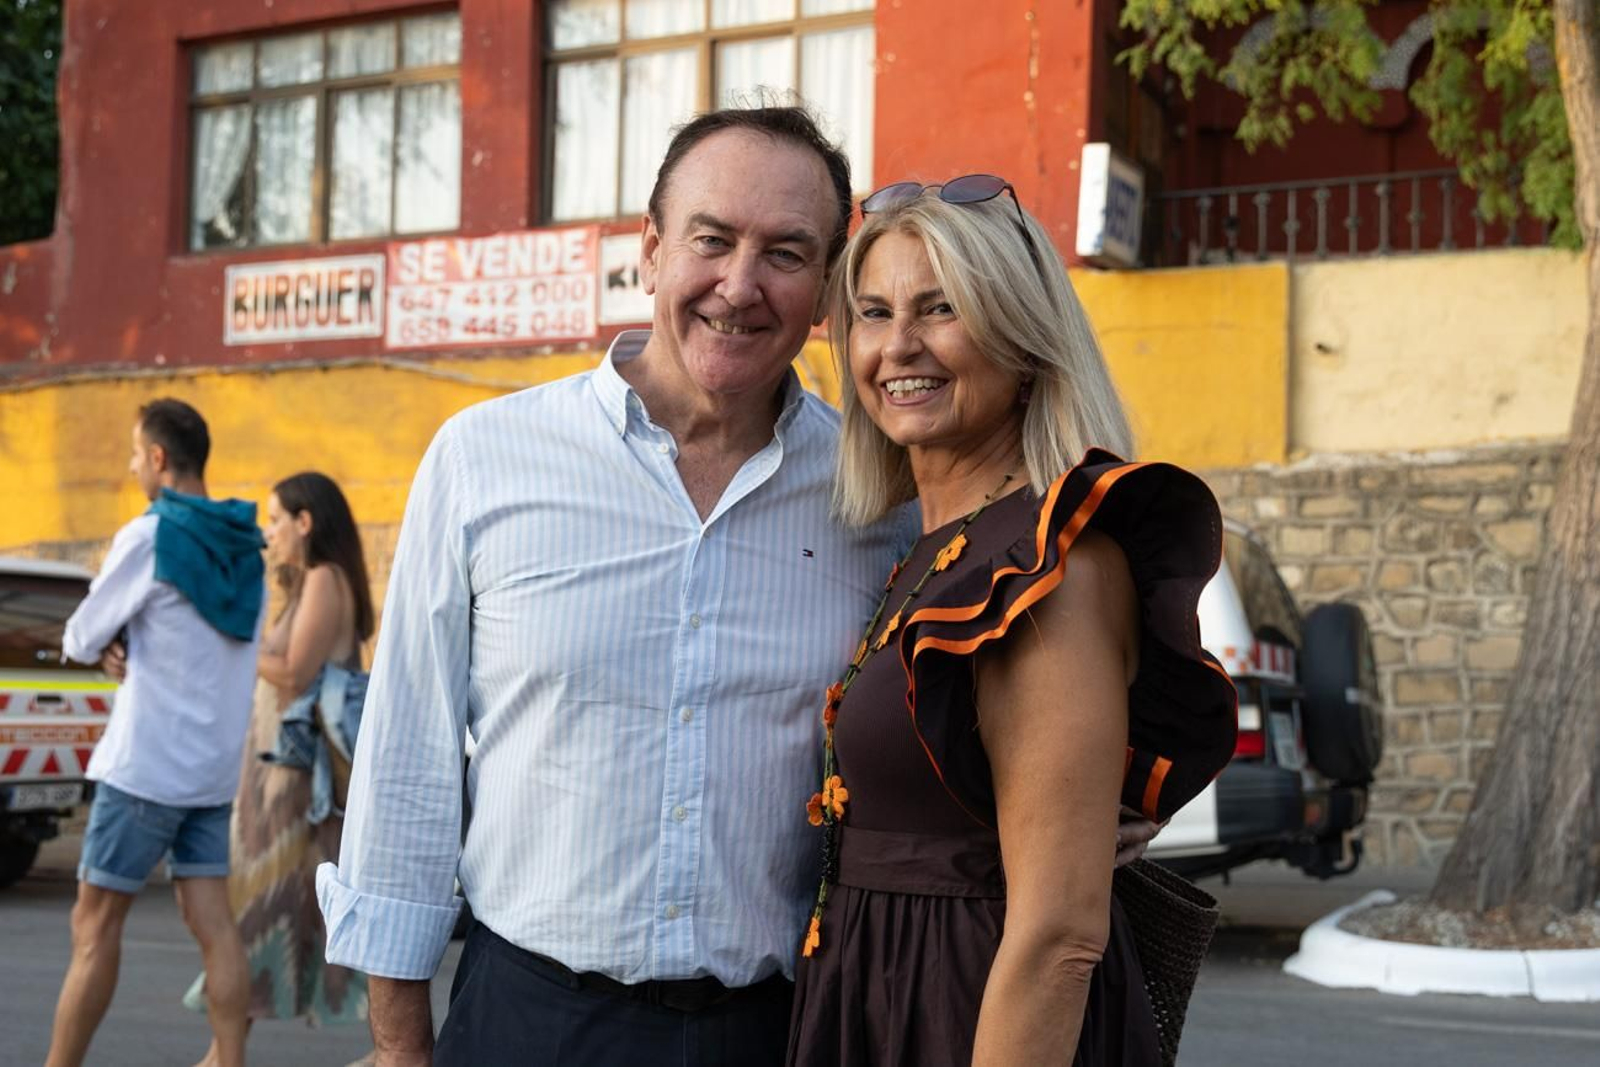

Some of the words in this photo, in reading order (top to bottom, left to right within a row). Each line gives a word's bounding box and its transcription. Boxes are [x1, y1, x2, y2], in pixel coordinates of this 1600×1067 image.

[399, 241, 448, 284] SE
[454, 229, 589, 280] VENDE
[234, 267, 375, 332] BURGUER
[531, 277, 587, 305] 000
